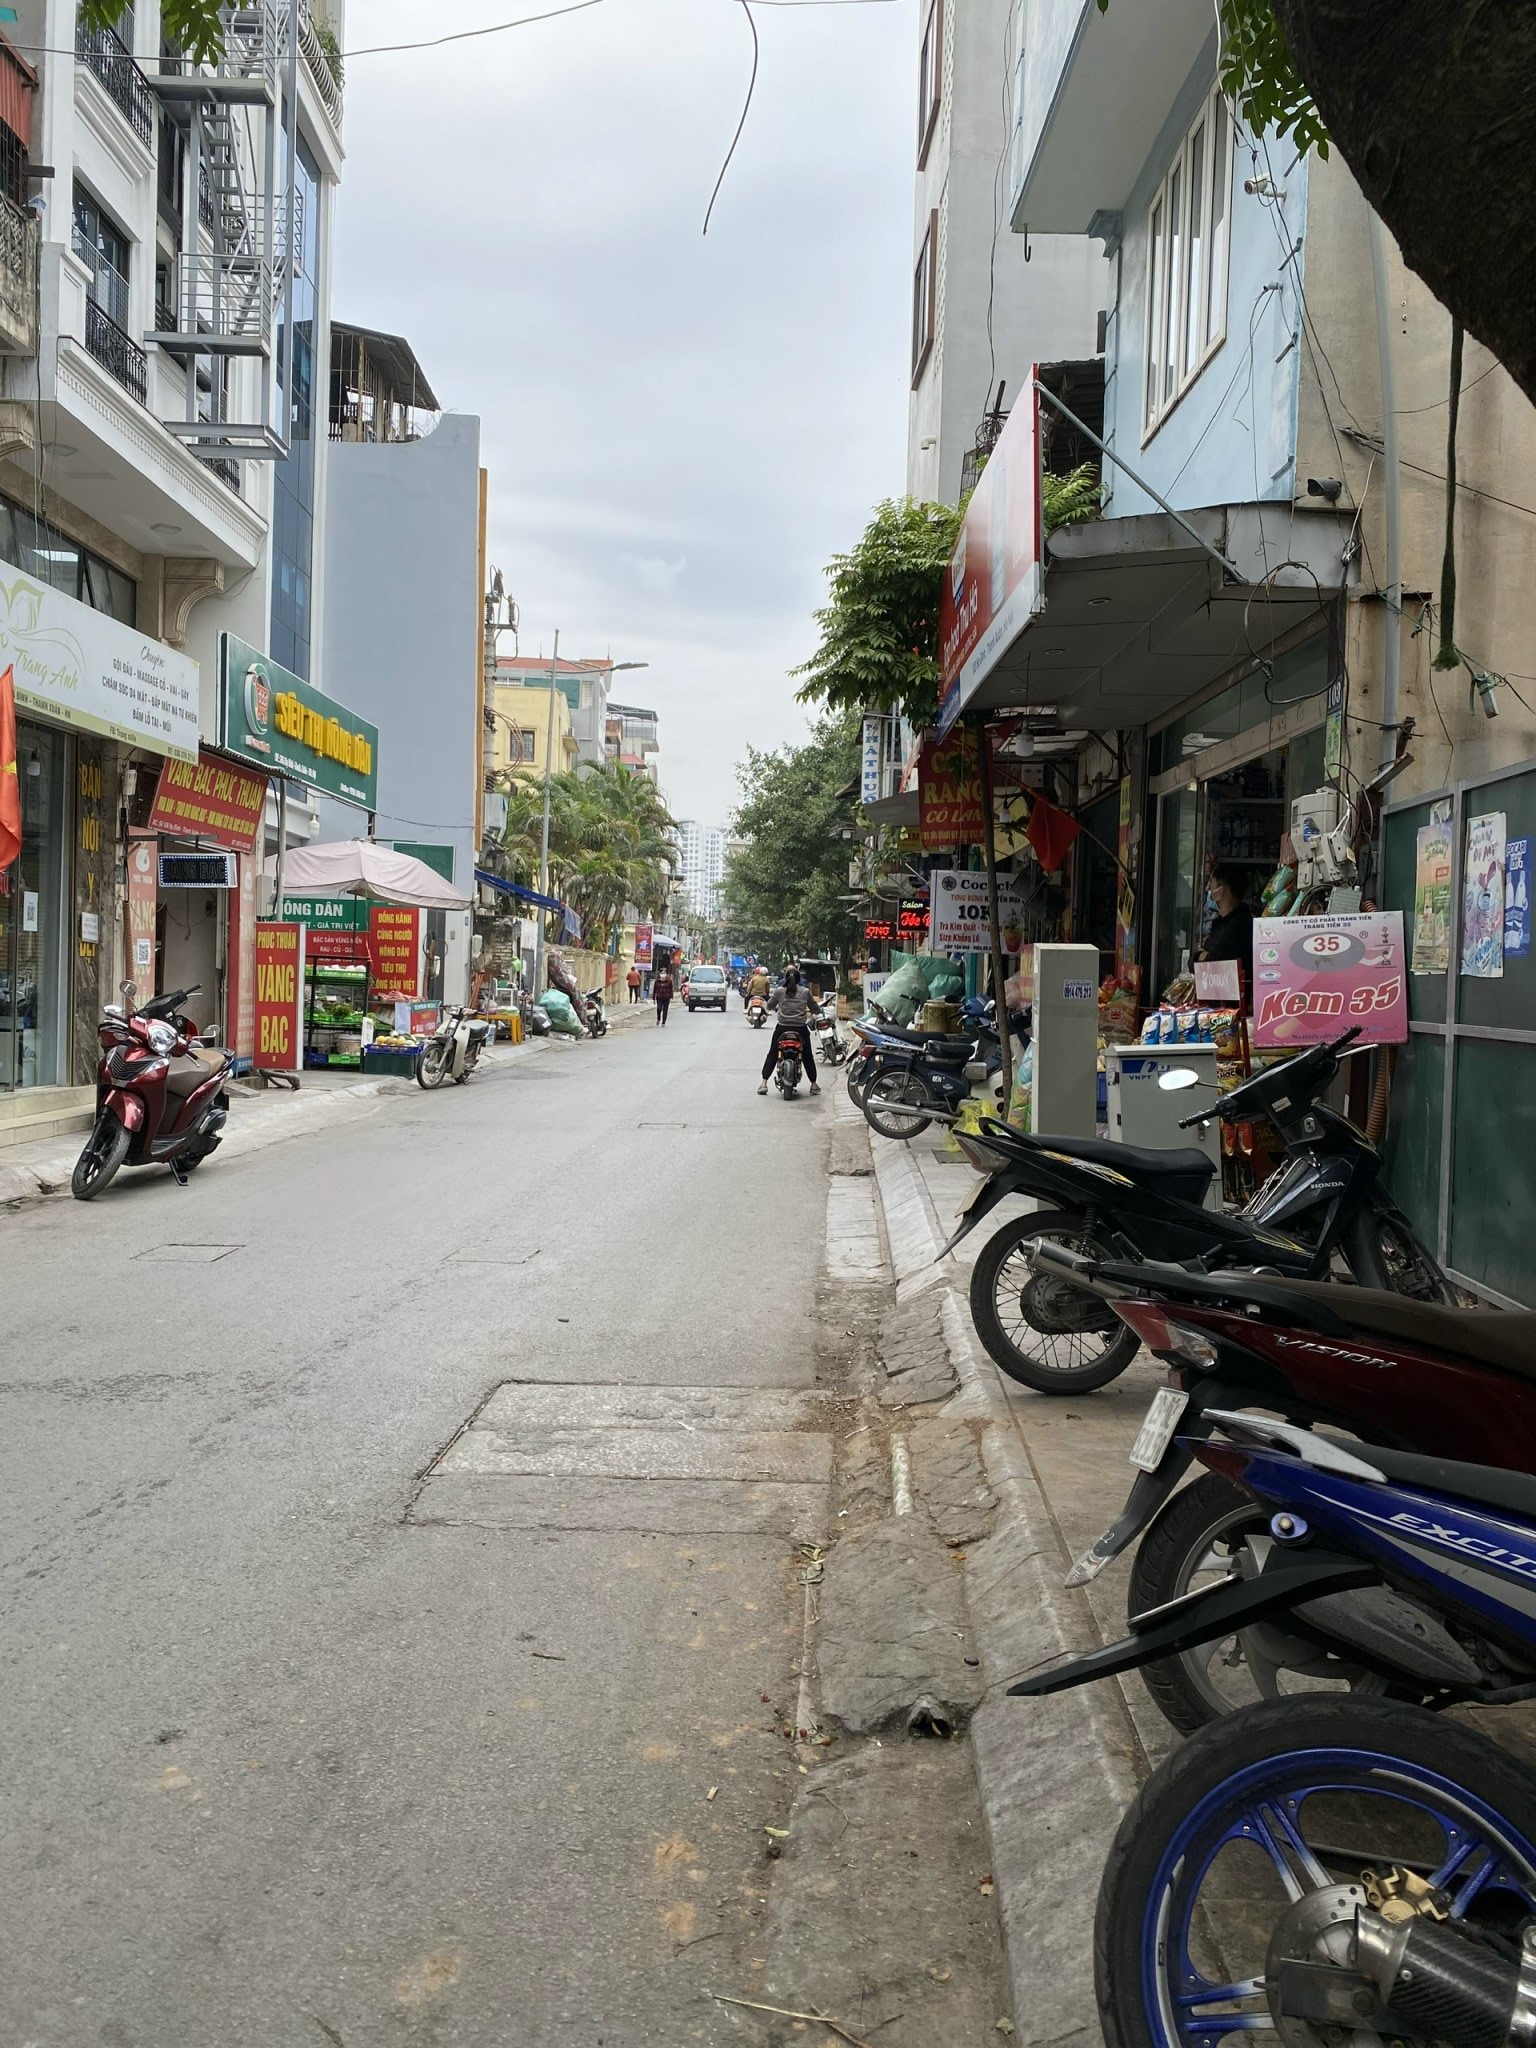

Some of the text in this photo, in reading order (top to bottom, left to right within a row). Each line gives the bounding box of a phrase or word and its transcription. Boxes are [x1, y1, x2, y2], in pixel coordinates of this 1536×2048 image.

[15, 645, 79, 692] Trang Anh
[137, 669, 159, 688] MASSAGE
[170, 684, 178, 696] VAI
[1328, 681, 1341, 709] 103
[275, 691, 305, 741] SIÊU
[304, 708, 325, 758] THỊ
[325, 717, 352, 769] NÔNG
[352, 733, 372, 776] DÂN
[79, 760, 100, 800] BÁN
[193, 763, 216, 800] BẠC
[926, 807, 949, 824] CÔ
[283, 900, 343, 917] ÔNG DÂN
[902, 900, 923, 910] Salon
[378, 910, 412, 924] ĐỒNG HÀNH
[317, 921, 329, 929] GIÁ
[331, 922, 343, 931] TRỊ
[377, 927, 393, 941] CÙNG
[950, 921, 962, 931] Kim
[258, 928, 297, 952] PHÚC THUẬN
[940, 933, 951, 943] Size
[1313, 936, 1340, 952] 35
[396, 944, 410, 957] DÂN
[381, 962, 394, 974] TIÊU
[257, 955, 294, 1003] VÀNG
[389, 978, 401, 990] SẢN
[402, 979, 415, 991] VIỆT
[1258, 975, 1401, 1031] Kem 35
[261, 1014, 289, 1062] BẠC
[1310, 1181, 1346, 1189] HONDA
[1273, 1333, 1398, 1369] VISION
[1389, 1513, 1536, 1575] EXCIT
